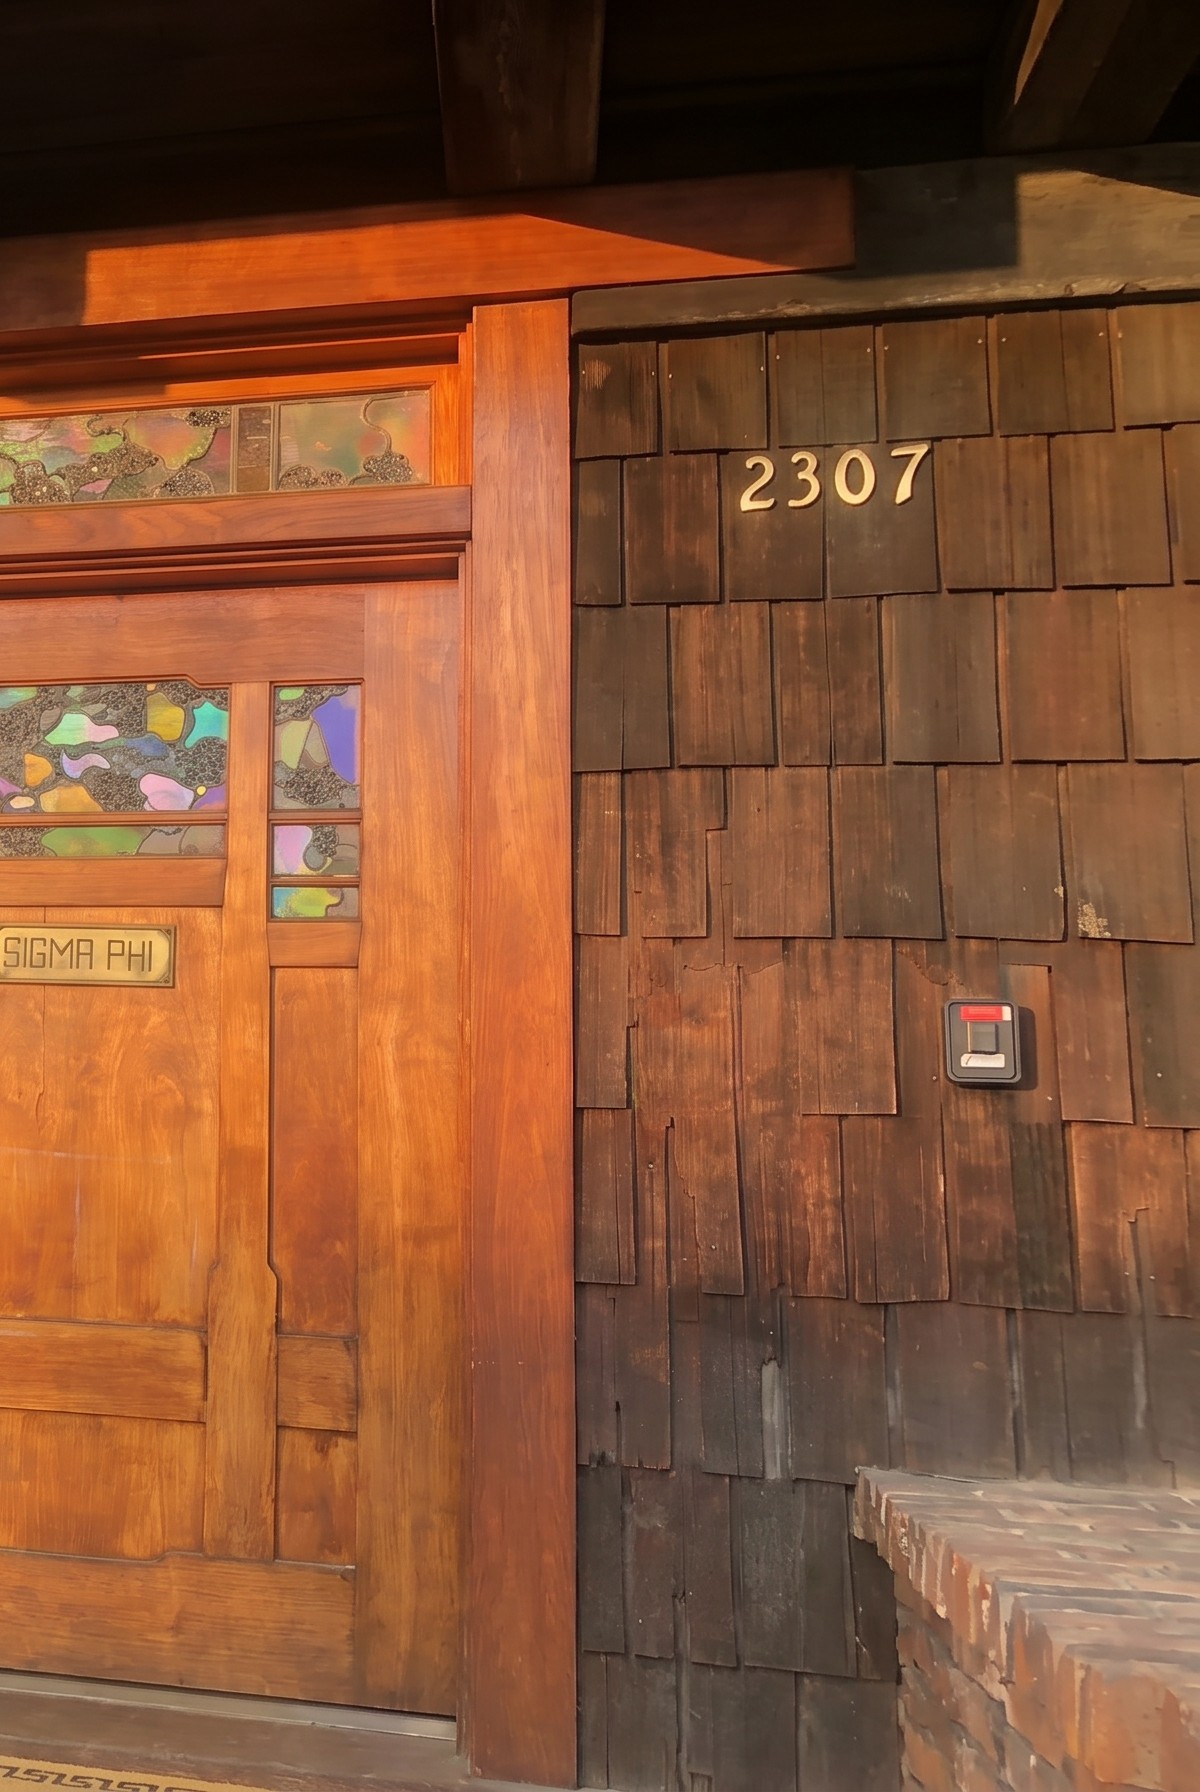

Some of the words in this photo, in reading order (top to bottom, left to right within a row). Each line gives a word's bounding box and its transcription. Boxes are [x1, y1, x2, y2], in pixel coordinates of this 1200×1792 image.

[740, 443, 929, 512] 2307
[3, 936, 94, 970] SIGMA
[106, 939, 153, 972] PHI
